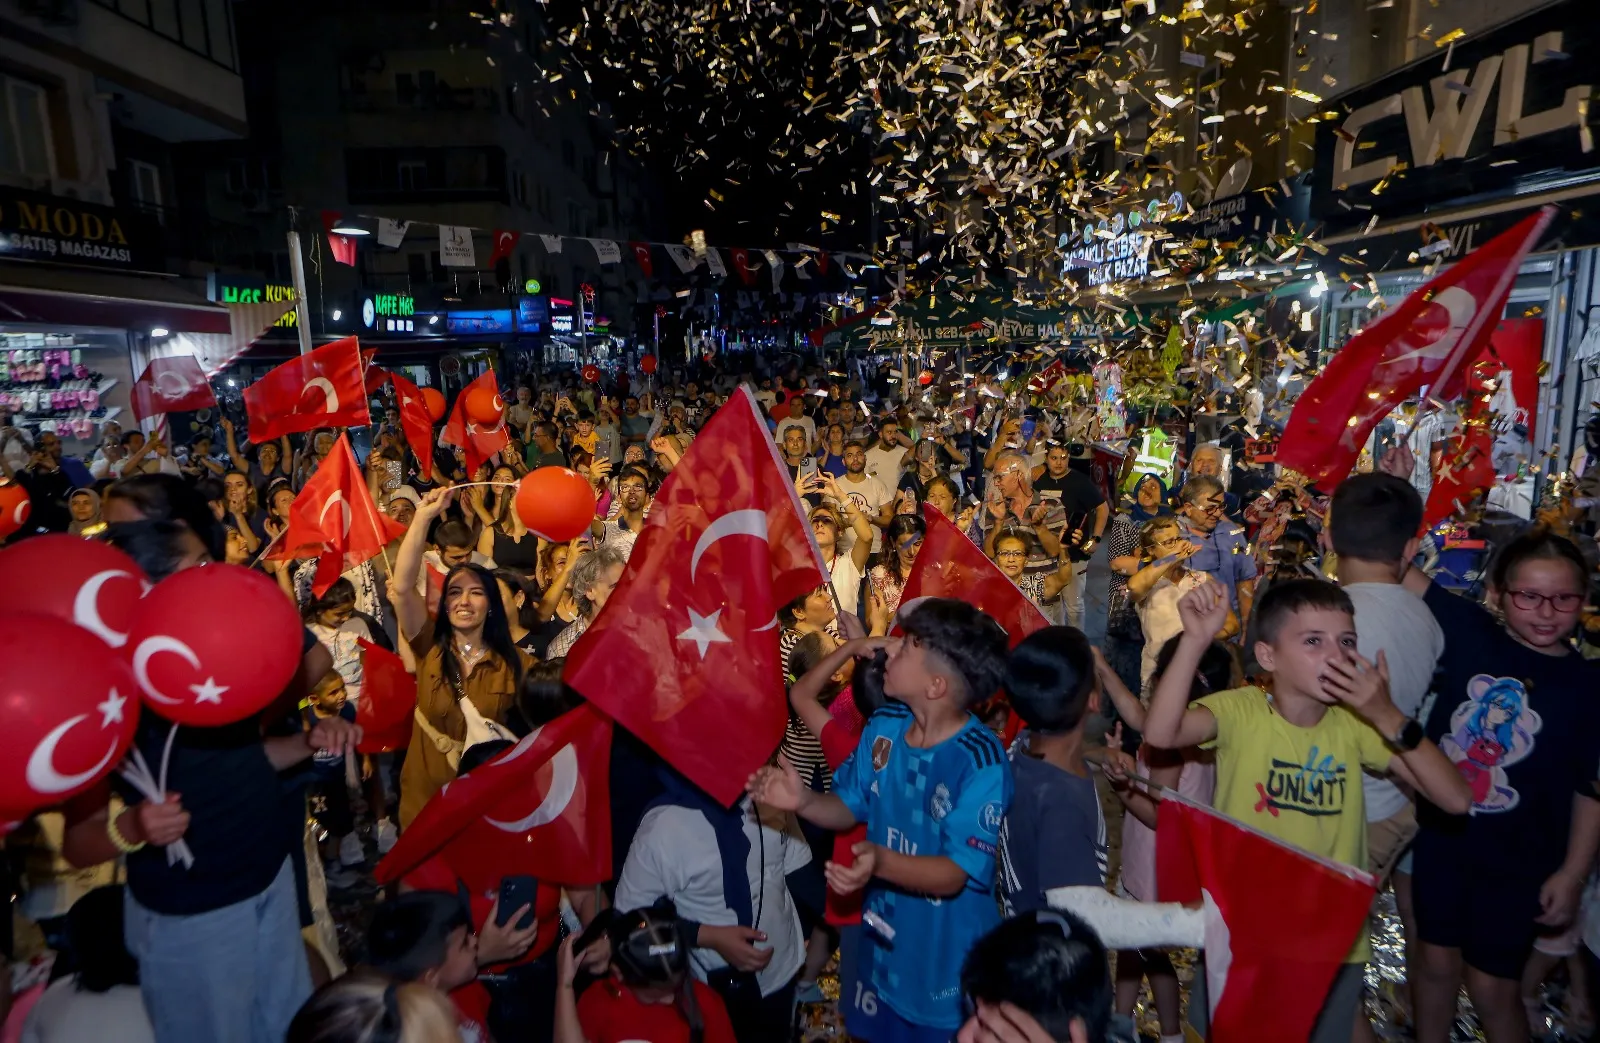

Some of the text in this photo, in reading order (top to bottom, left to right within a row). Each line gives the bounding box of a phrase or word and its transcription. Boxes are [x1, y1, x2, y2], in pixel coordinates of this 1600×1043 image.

[16, 200, 128, 245] MODA
[60, 241, 131, 262] MAĞAZASI
[376, 294, 414, 316] KAFE HAS
[994, 322, 1034, 337] MEYVE
[855, 980, 878, 1017] 16
